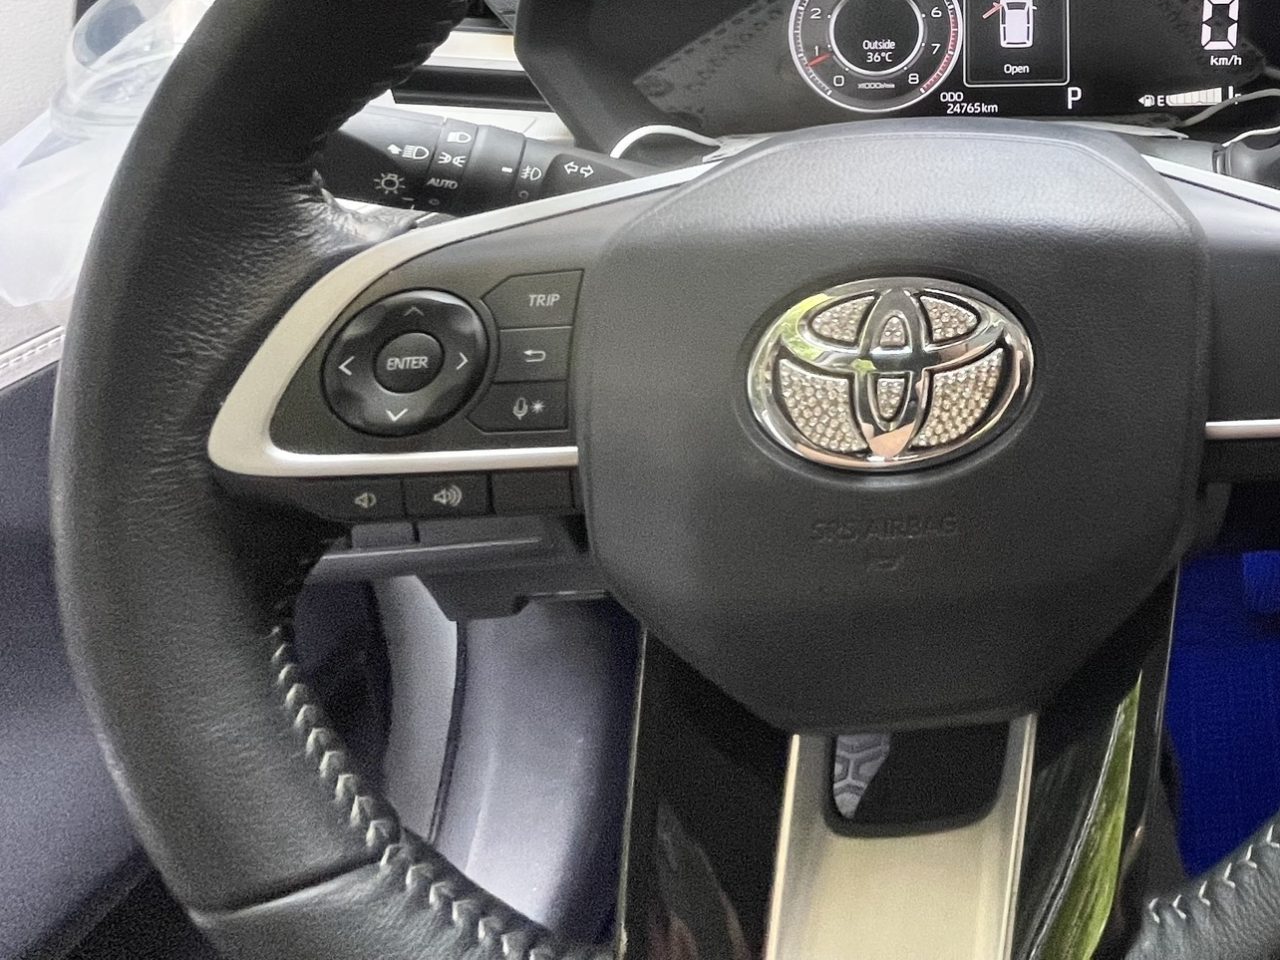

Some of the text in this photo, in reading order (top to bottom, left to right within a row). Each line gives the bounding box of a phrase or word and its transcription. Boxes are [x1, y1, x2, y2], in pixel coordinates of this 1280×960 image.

[810, 8, 821, 19] 2
[931, 7, 942, 18] 6
[814, 45, 820, 56] 1
[862, 40, 896, 51] Outside
[931, 43, 942, 55] 7
[866, 52, 893, 63] 36°C
[1209, 55, 1242, 66] km/h
[1003, 64, 1030, 75] Open
[833, 75, 845, 87] 0
[908, 73, 920, 84] 8
[940, 91, 964, 102] ODO
[1067, 86, 1082, 110] P
[1156, 95, 1166, 106] E
[426, 177, 459, 191] AUTO
[528, 292, 561, 308] TRIP
[386, 355, 429, 371] ENTER
